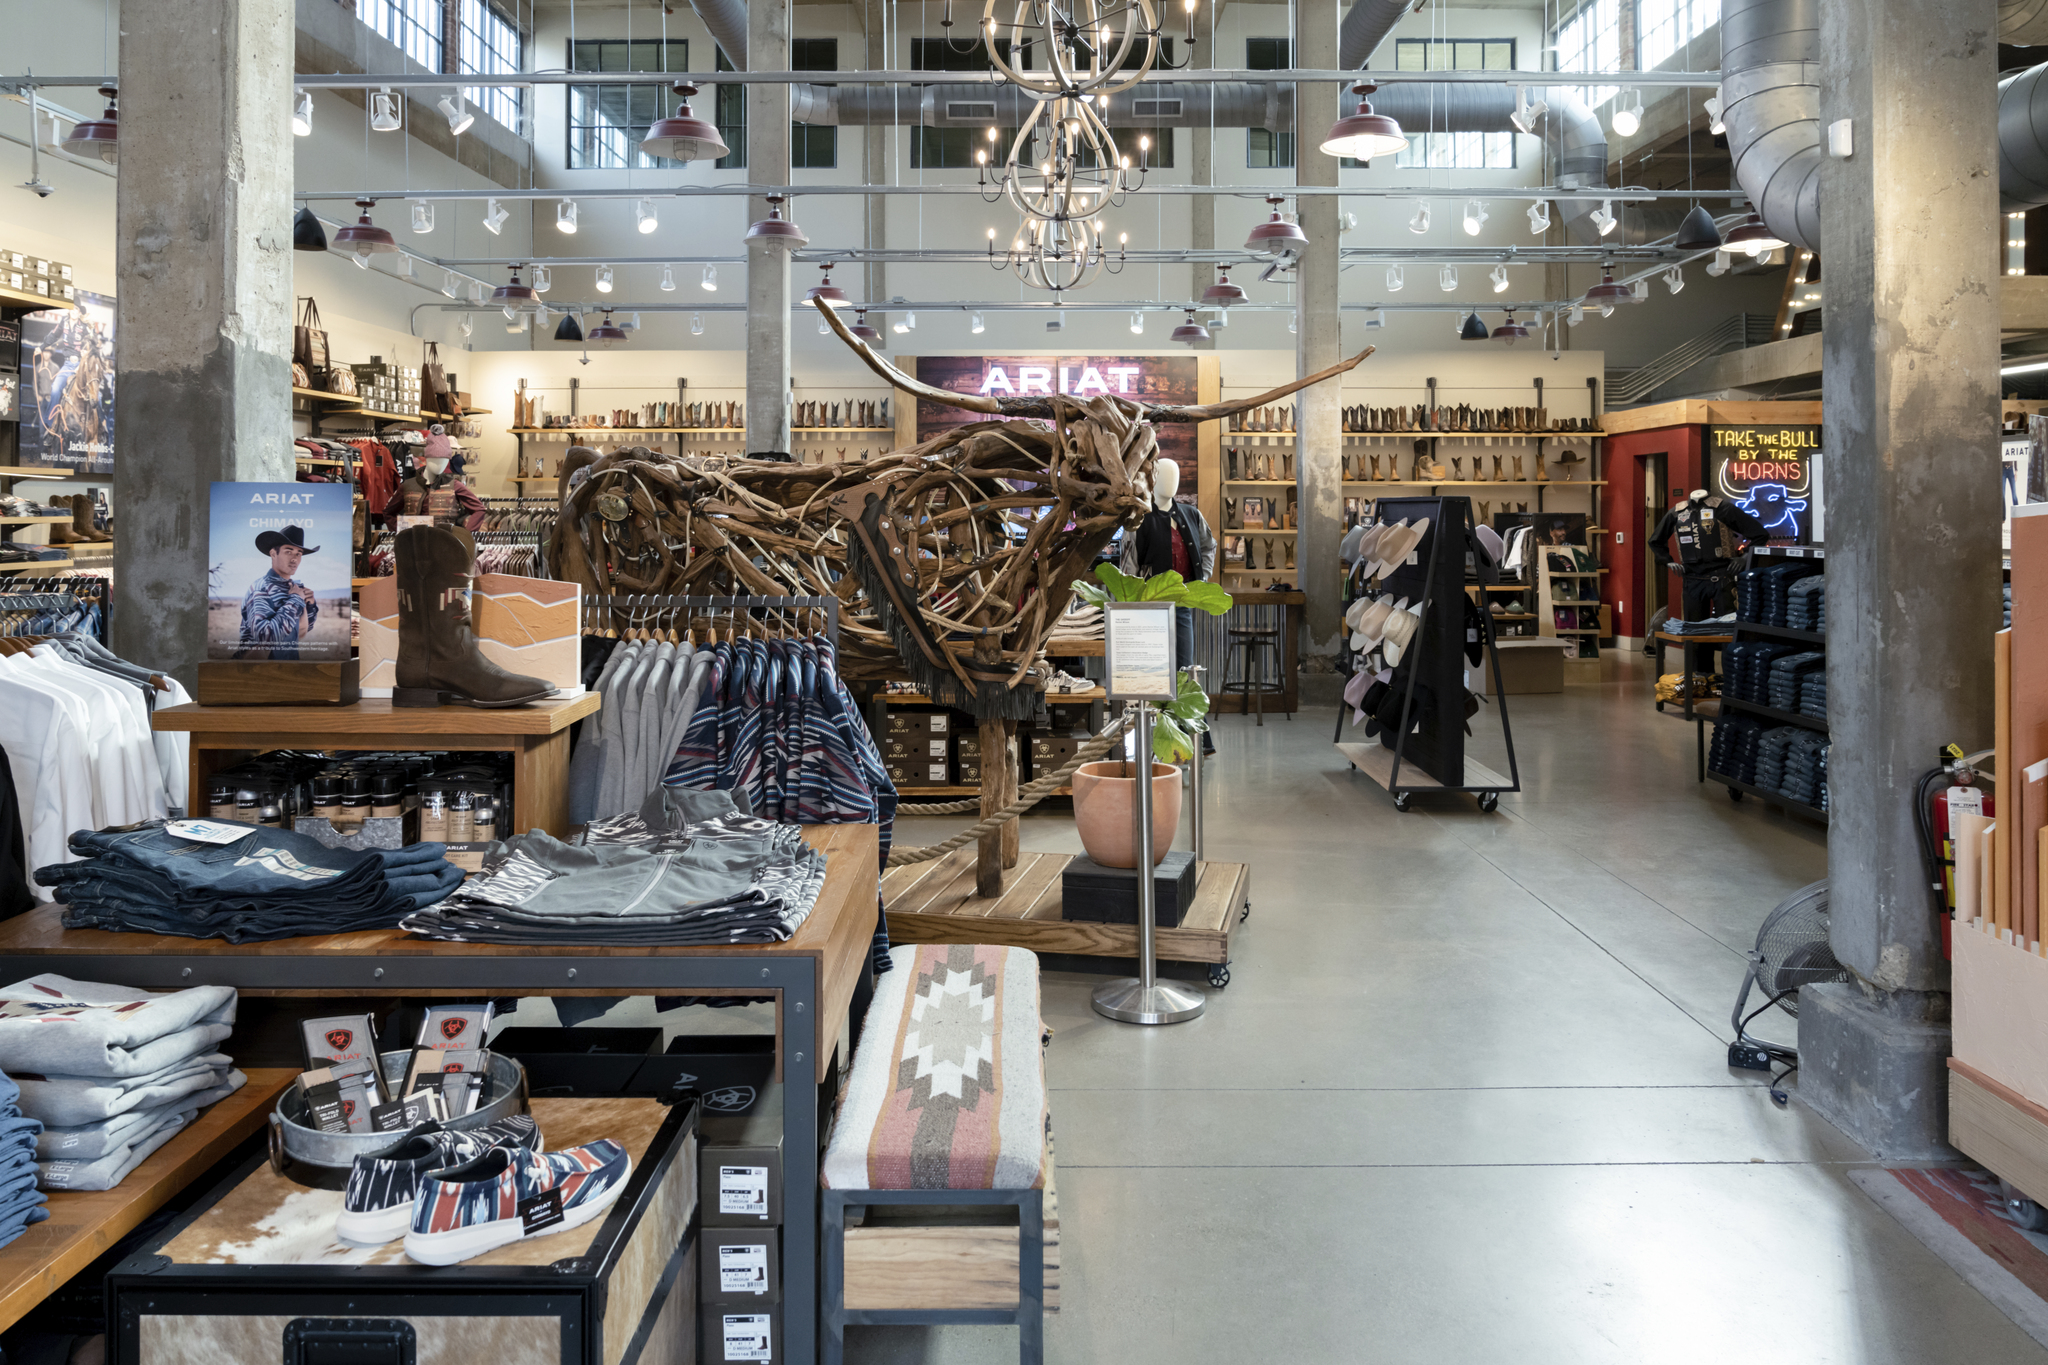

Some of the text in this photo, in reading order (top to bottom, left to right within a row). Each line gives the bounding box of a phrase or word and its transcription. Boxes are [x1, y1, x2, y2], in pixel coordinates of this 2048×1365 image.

[979, 367, 1139, 393] ARIAT
[1714, 430, 1818, 447] TAKE THE BULL
[68, 441, 88, 452] Jackie
[2005, 447, 2029, 456] ARIAT
[41, 453, 58, 461] World
[60, 454, 87, 464] Champion
[1739, 449, 1798, 460] BY THE
[1734, 462, 1801, 480] HORNS
[250, 493, 314, 504] ARIAT
[250, 518, 314, 528] CHIMAYO
[1692, 522, 1701, 549] ARIAT
[320, 1101, 338, 1109] ARIAT
[383, 1109, 401, 1118] ARIAT
[348, 1117, 363, 1125] IAT
[529, 1201, 552, 1214] ARIAT
